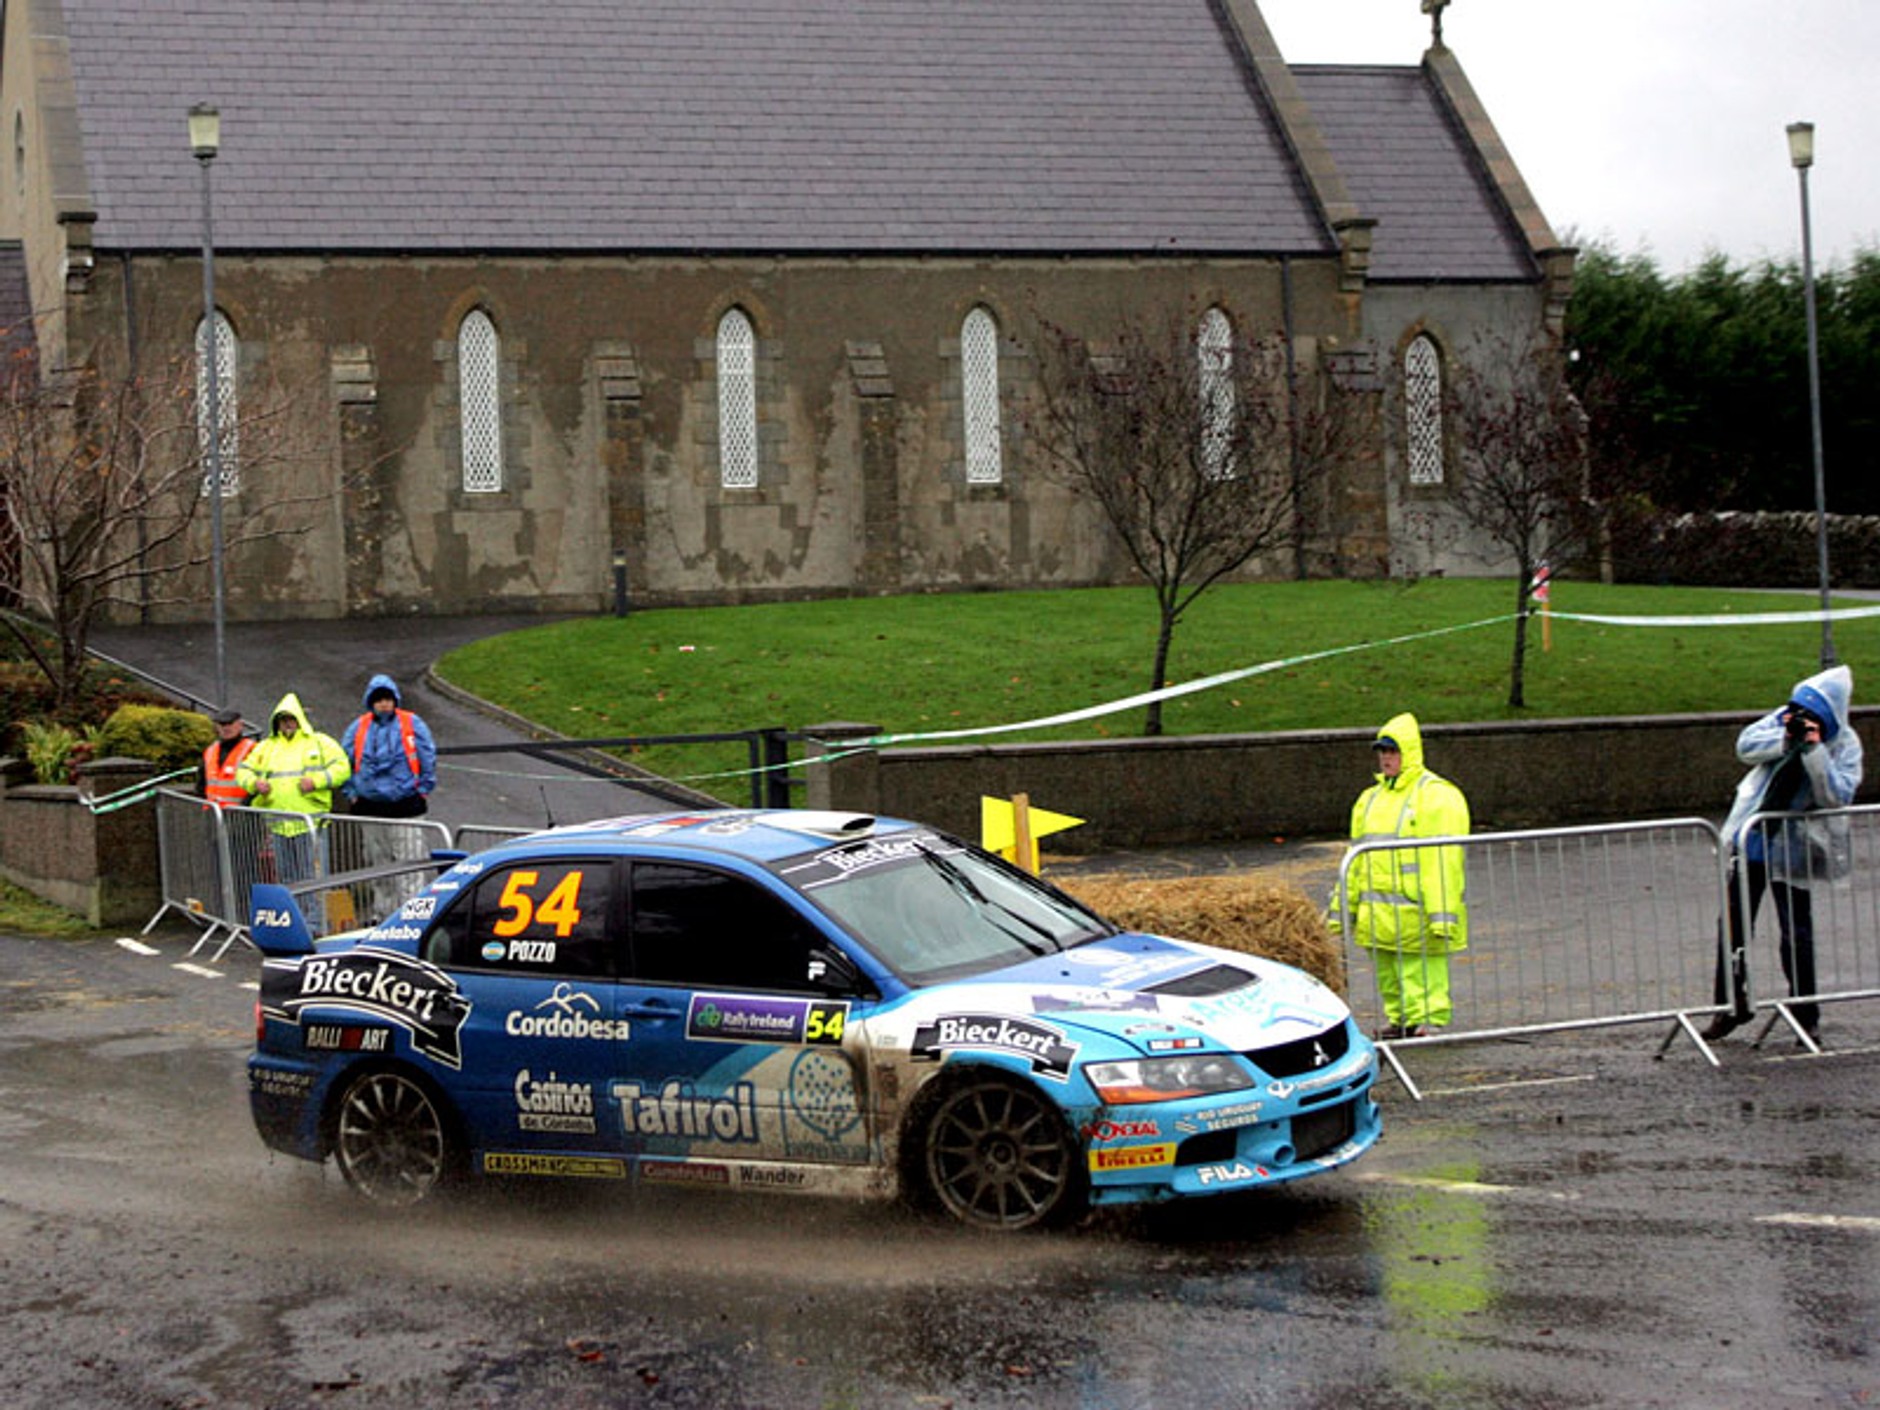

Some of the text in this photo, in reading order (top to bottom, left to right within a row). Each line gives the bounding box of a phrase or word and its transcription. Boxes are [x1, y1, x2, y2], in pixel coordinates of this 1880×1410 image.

[403, 899, 434, 913] NGK
[492, 870, 583, 937] 54
[254, 910, 291, 928] FILA
[508, 939, 556, 963] POZZO
[300, 957, 436, 1021] Bieckert
[505, 1010, 630, 1040] Cordobesa
[806, 1009, 844, 1040] 54
[938, 1017, 1056, 1054] Bieckert
[514, 1068, 594, 1115] Casinos
[611, 1080, 756, 1140] Tafirol
[1096, 1147, 1166, 1167] PIRELLI
[739, 1166, 806, 1185] Wander
[1197, 1162, 1254, 1185] FILA
